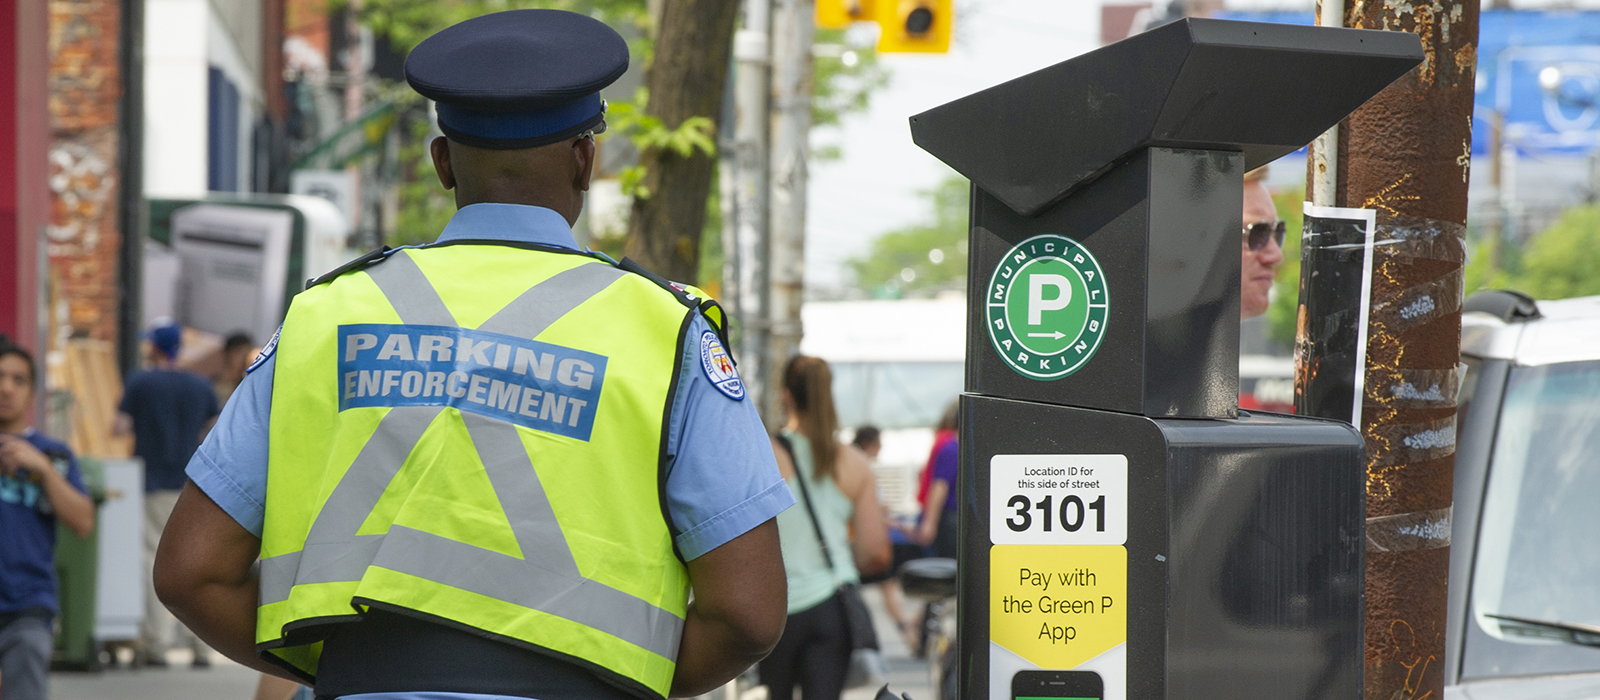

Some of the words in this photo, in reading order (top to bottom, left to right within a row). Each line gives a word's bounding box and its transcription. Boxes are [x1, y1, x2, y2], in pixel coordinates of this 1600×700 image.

[994, 242, 1100, 300] MUNICIPAL
[1027, 273, 1073, 326] P
[344, 333, 595, 391] PARKING
[994, 318, 1100, 370] PARKING
[344, 369, 588, 428] ENFORCEMENT
[1018, 479, 1036, 489] this
[1037, 479, 1057, 489] side
[1059, 479, 1070, 489] of
[1071, 480, 1100, 489] street
[1024, 466, 1066, 477] Location
[1067, 466, 1078, 477] ID
[1080, 466, 1094, 477] for
[1006, 494, 1106, 533] 3101
[1019, 568, 1053, 591] Pay
[1057, 568, 1097, 587] with
[1003, 595, 1033, 614] the
[1038, 595, 1095, 614] Green
[1101, 596, 1113, 614] P
[1038, 622, 1077, 644] App
